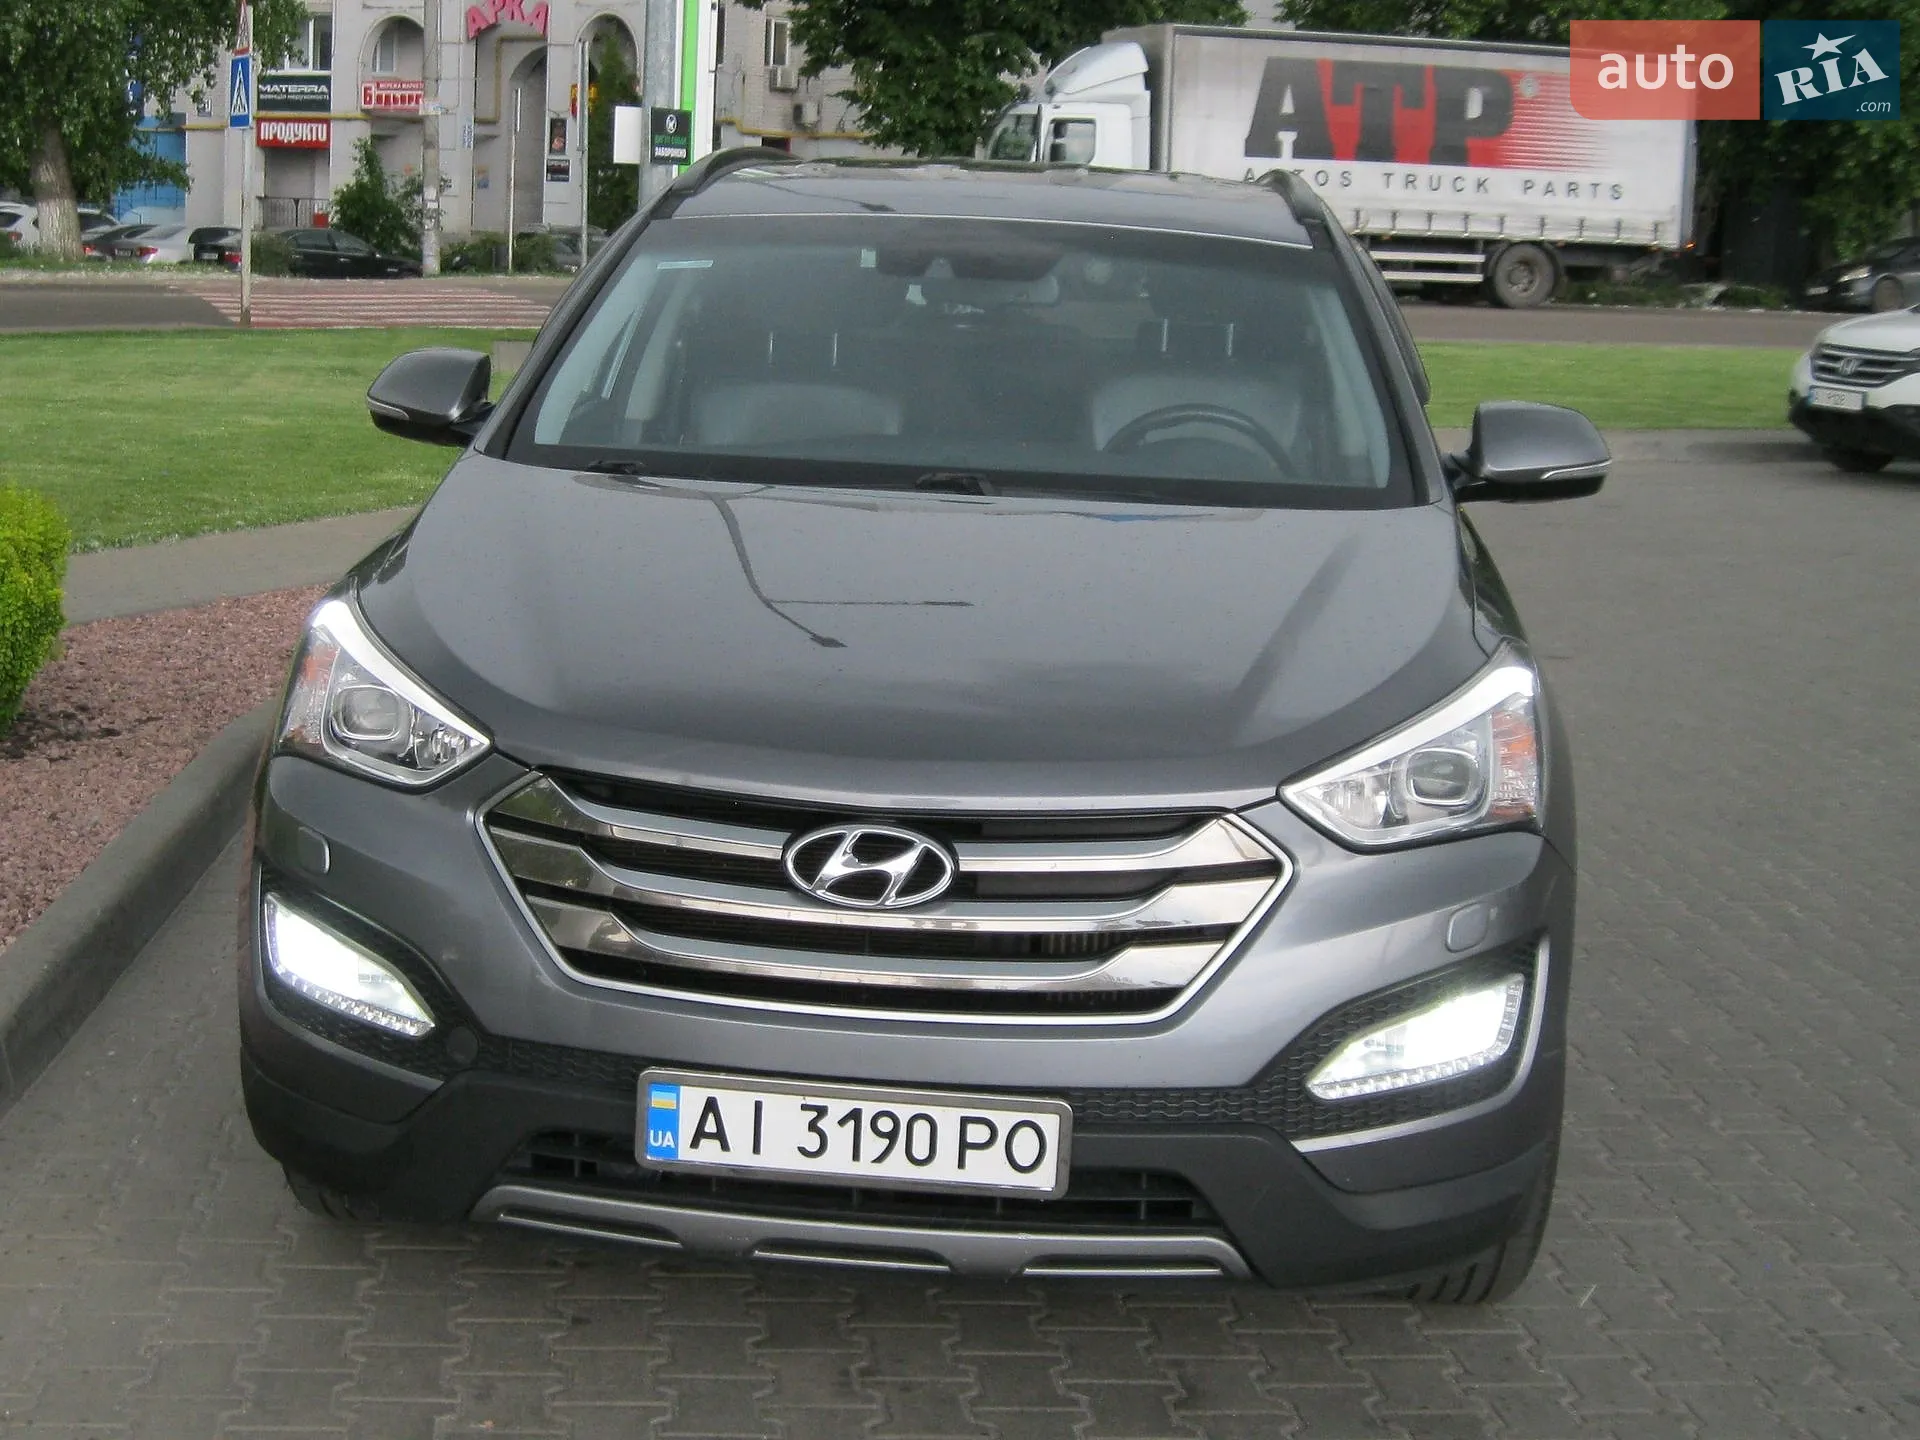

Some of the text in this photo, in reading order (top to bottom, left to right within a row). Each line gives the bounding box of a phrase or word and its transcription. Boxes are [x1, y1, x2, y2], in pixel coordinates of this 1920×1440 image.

[258, 84, 328, 93] MATERRA
[1244, 56, 1515, 166] ATP
[1243, 167, 1624, 200] AOS TRUCK PARTS
[649, 1130, 676, 1149] UA
[688, 1096, 1048, 1174] AI 3190 PO
